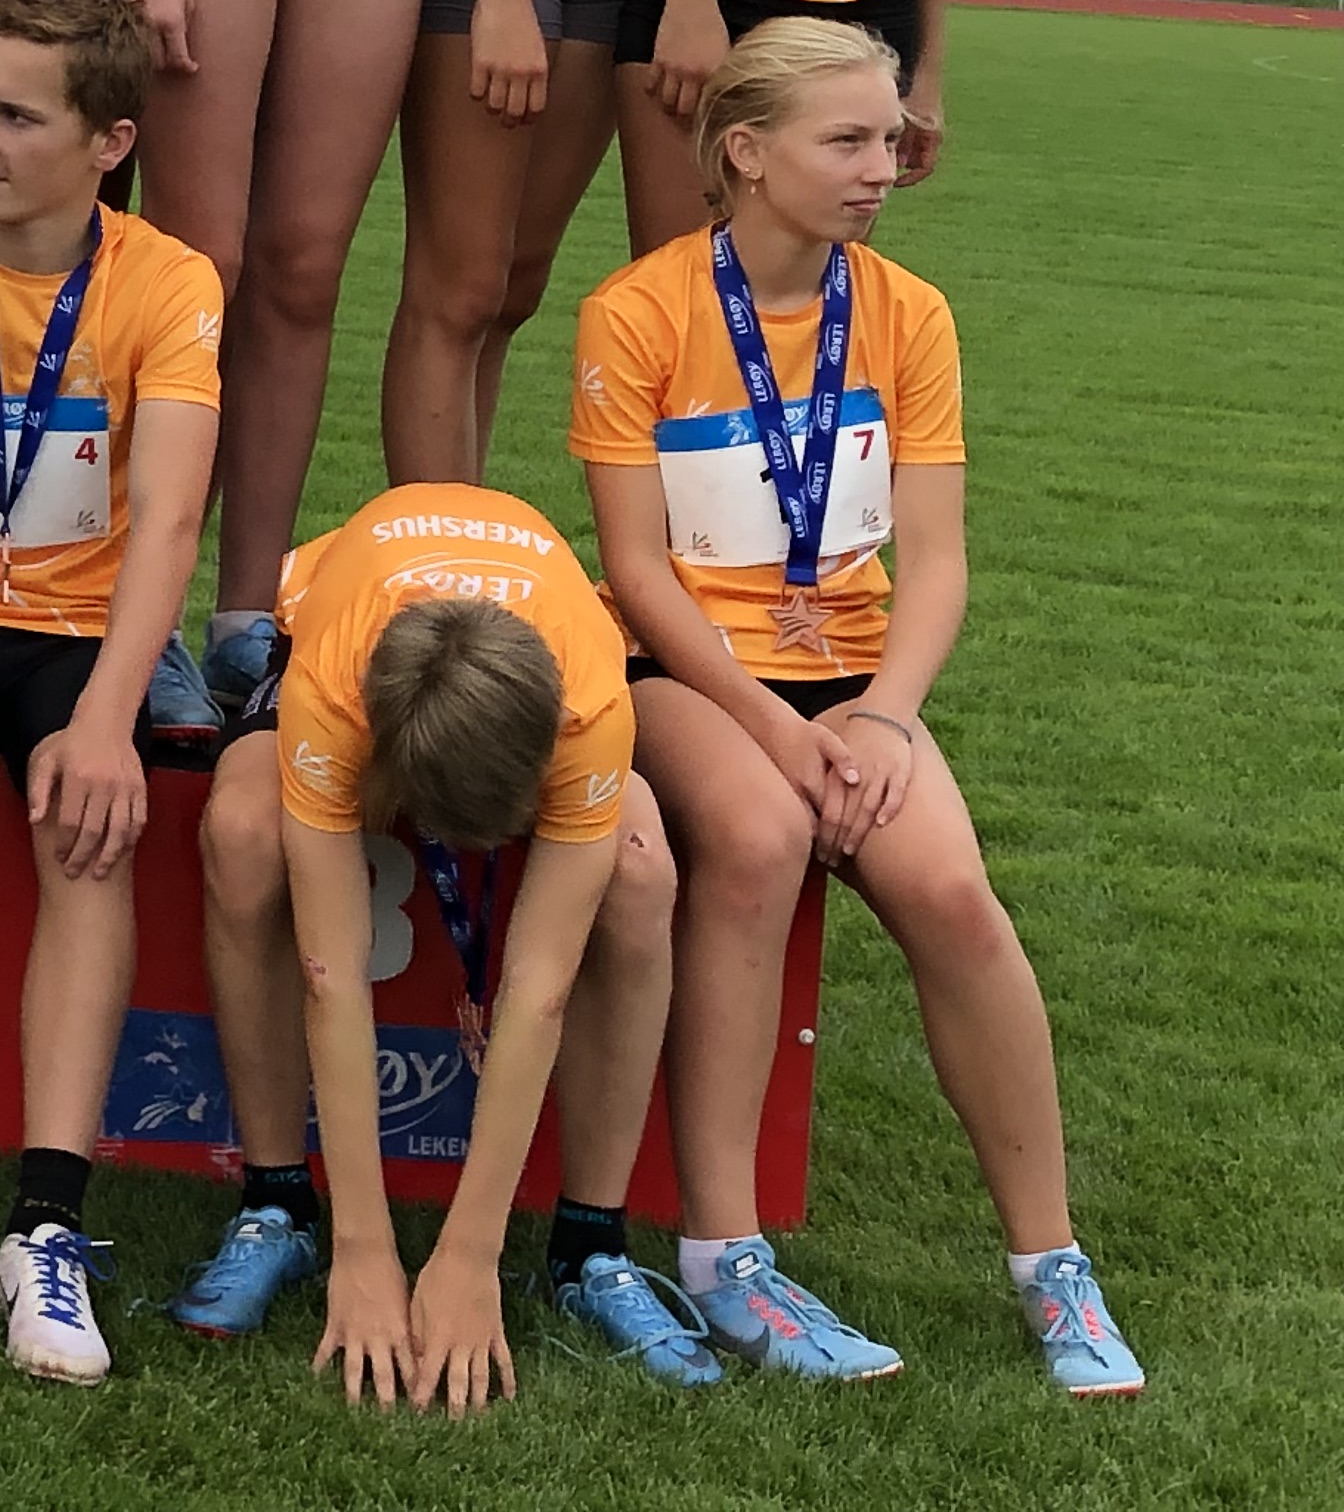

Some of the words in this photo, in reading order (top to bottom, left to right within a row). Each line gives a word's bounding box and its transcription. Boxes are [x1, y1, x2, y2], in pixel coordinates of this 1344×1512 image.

[75, 438, 98, 465] 4
[853, 429, 876, 461] 7
[372, 514, 556, 556] AKERSHUS
